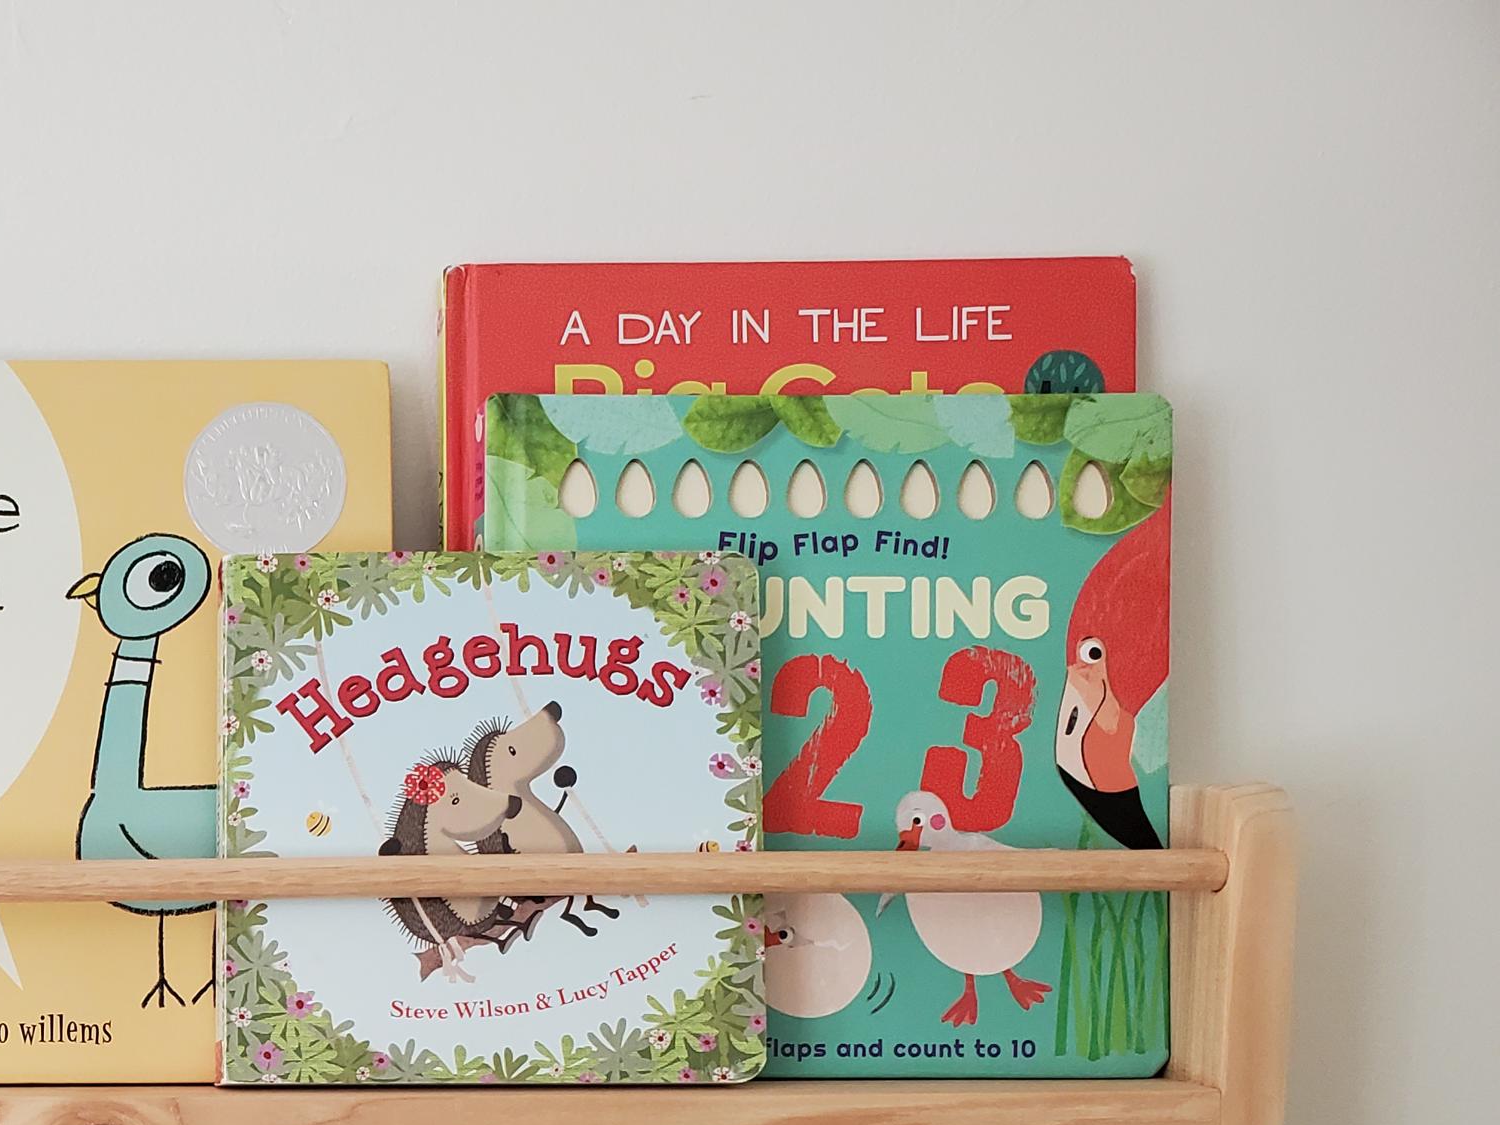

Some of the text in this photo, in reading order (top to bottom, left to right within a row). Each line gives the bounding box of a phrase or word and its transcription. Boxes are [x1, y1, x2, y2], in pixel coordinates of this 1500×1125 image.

[560, 306, 1012, 345] A DAY IN THE LIFE
[718, 530, 950, 566] Flip Flap Find!
[276, 623, 691, 753] Hedgehugs
[762, 645, 1037, 839] 2 3
[390, 942, 679, 1020] Steve Wilson & Lucy Tapper
[19, 1014, 113, 1046] willems
[837, 1038, 883, 1058] and
[893, 1039, 965, 1058] count
[974, 1039, 1001, 1058] to
[1011, 1039, 1036, 1058] 10
